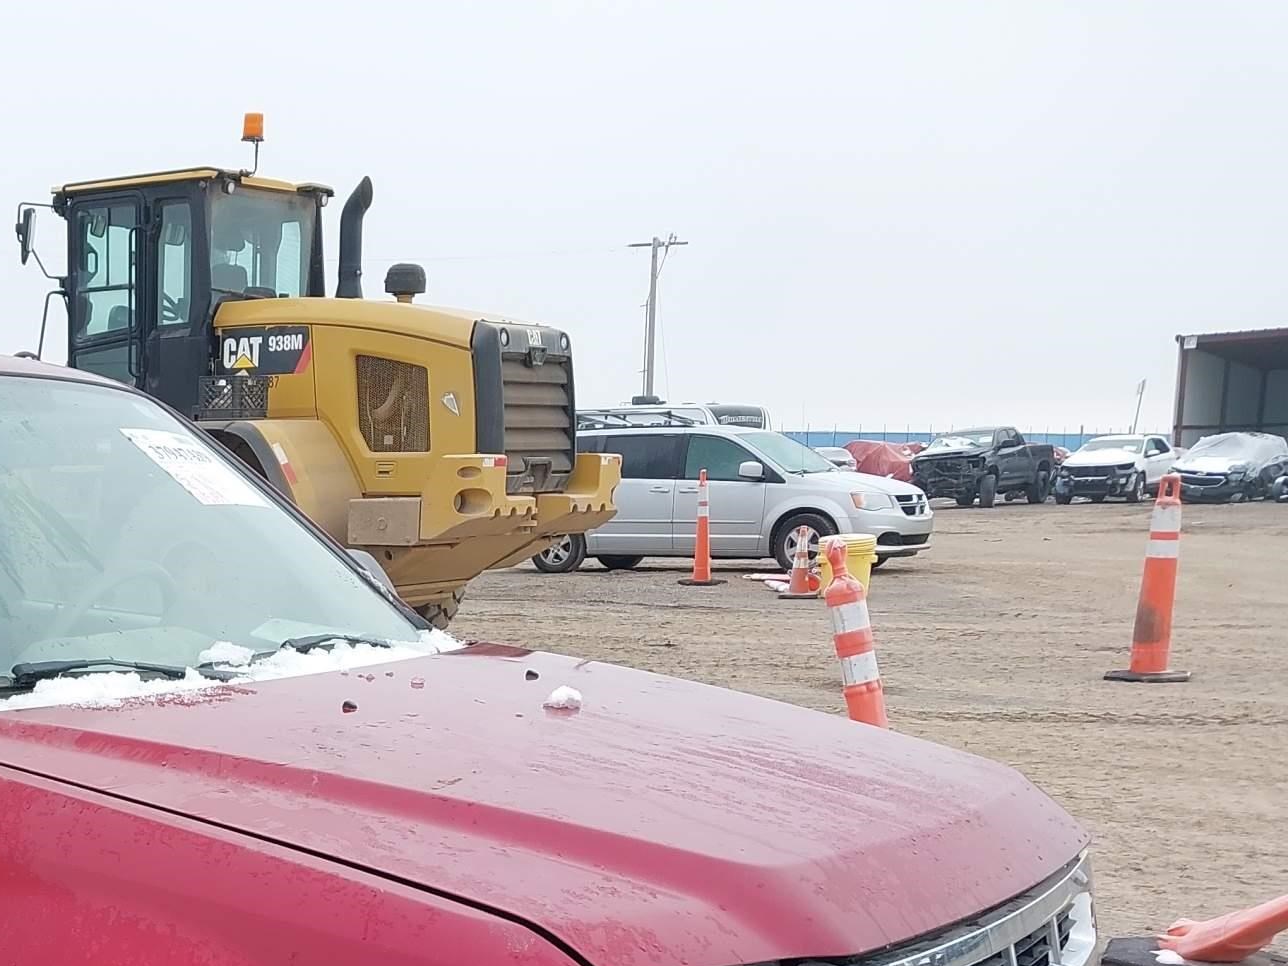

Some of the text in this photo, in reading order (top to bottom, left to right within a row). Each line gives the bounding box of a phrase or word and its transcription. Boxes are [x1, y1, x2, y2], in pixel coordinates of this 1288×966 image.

[527, 329, 542, 345] CAT
[223, 334, 303, 369] CAT 938M
